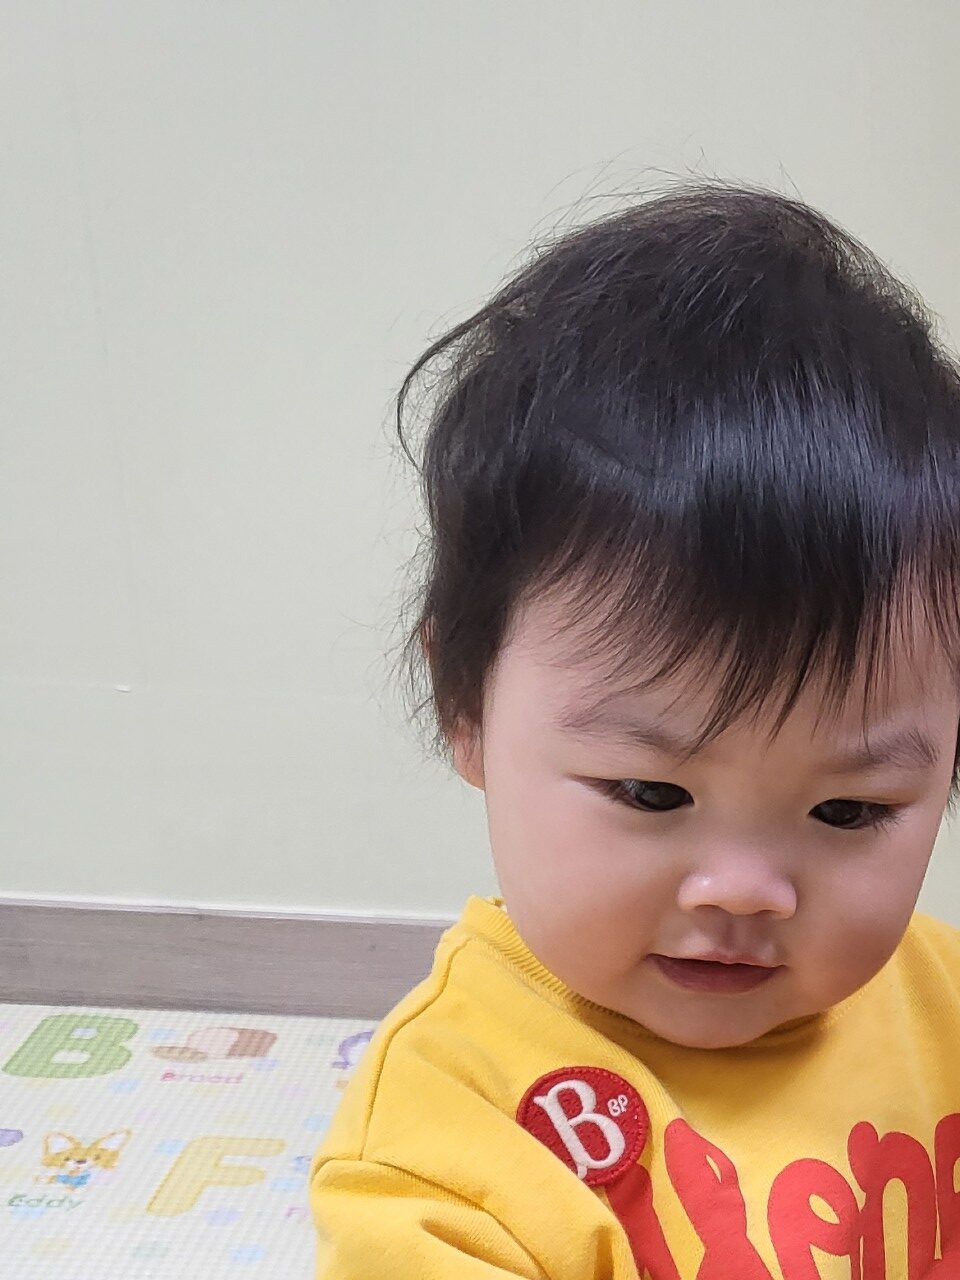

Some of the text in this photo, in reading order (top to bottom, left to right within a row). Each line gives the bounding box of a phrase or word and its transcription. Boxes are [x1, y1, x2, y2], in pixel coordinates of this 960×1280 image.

[2, 1014, 139, 1078] B
[533, 1079, 626, 1180] B
[146, 1136, 286, 1217] F
